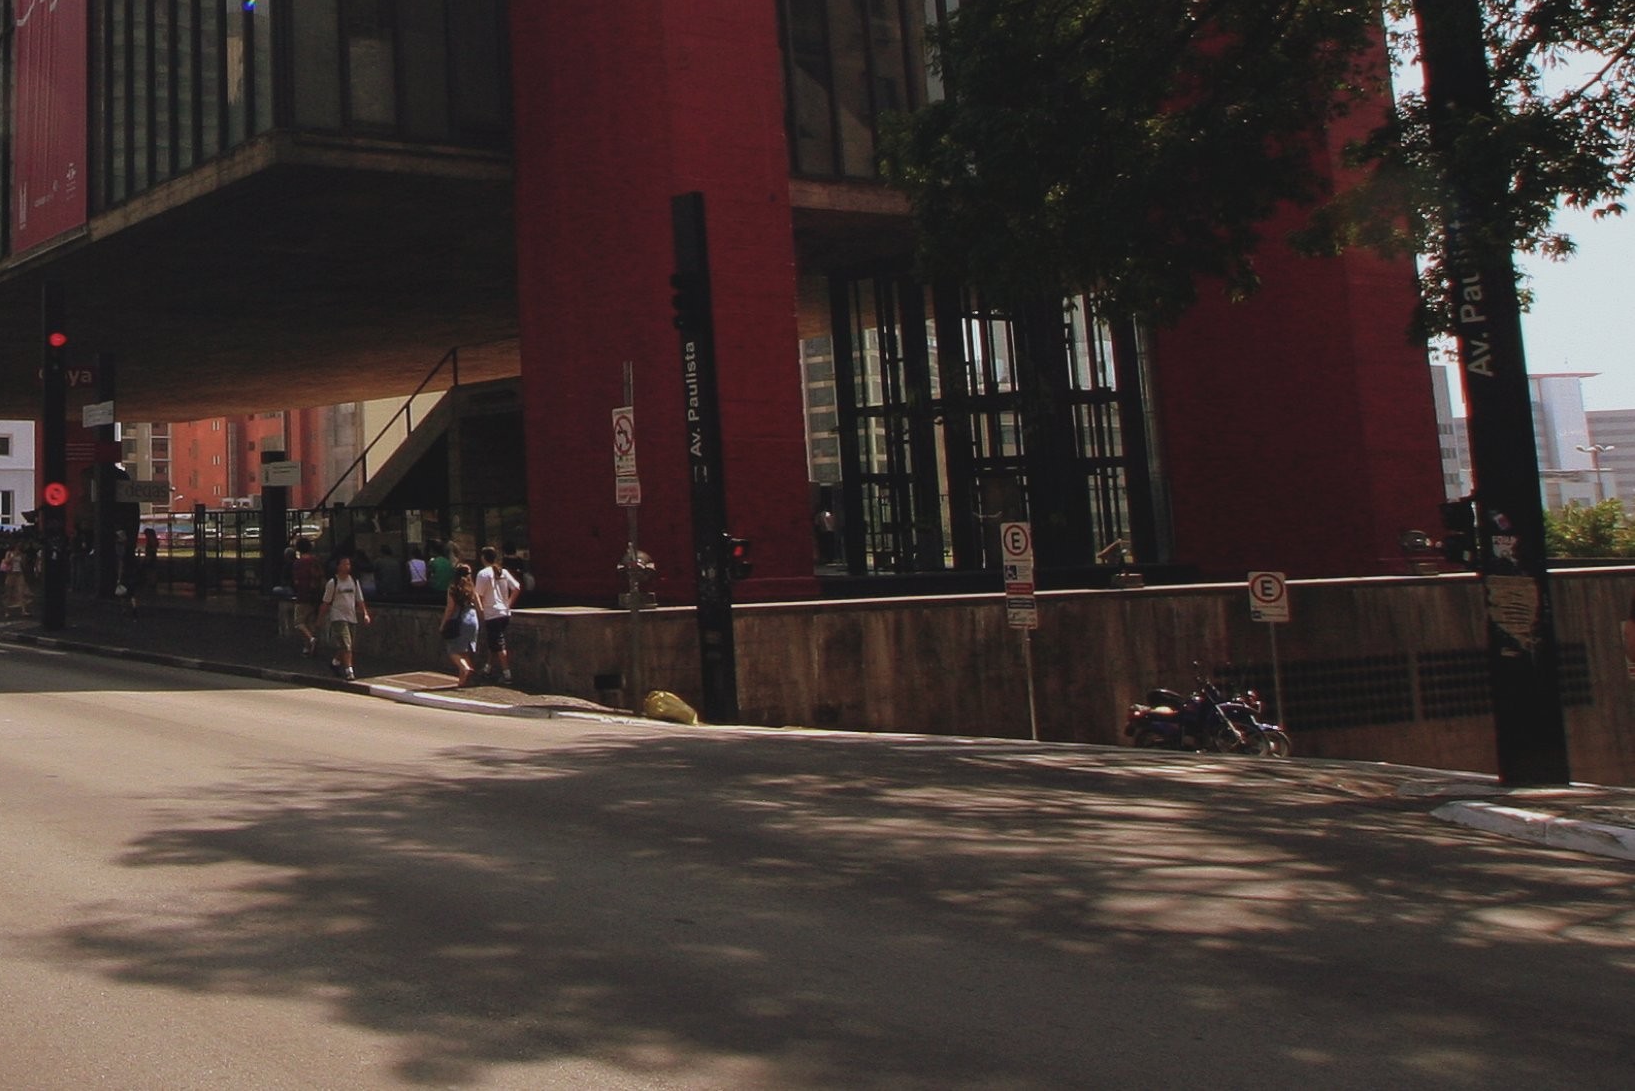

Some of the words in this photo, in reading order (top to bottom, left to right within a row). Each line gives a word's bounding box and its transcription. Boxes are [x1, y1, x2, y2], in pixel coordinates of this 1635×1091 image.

[1467, 331, 1495, 378] Av.
[684, 341, 700, 422] Paulista
[690, 427, 702, 457] Av.
[1011, 532, 1021, 550] E
[1261, 580, 1274, 597] E
